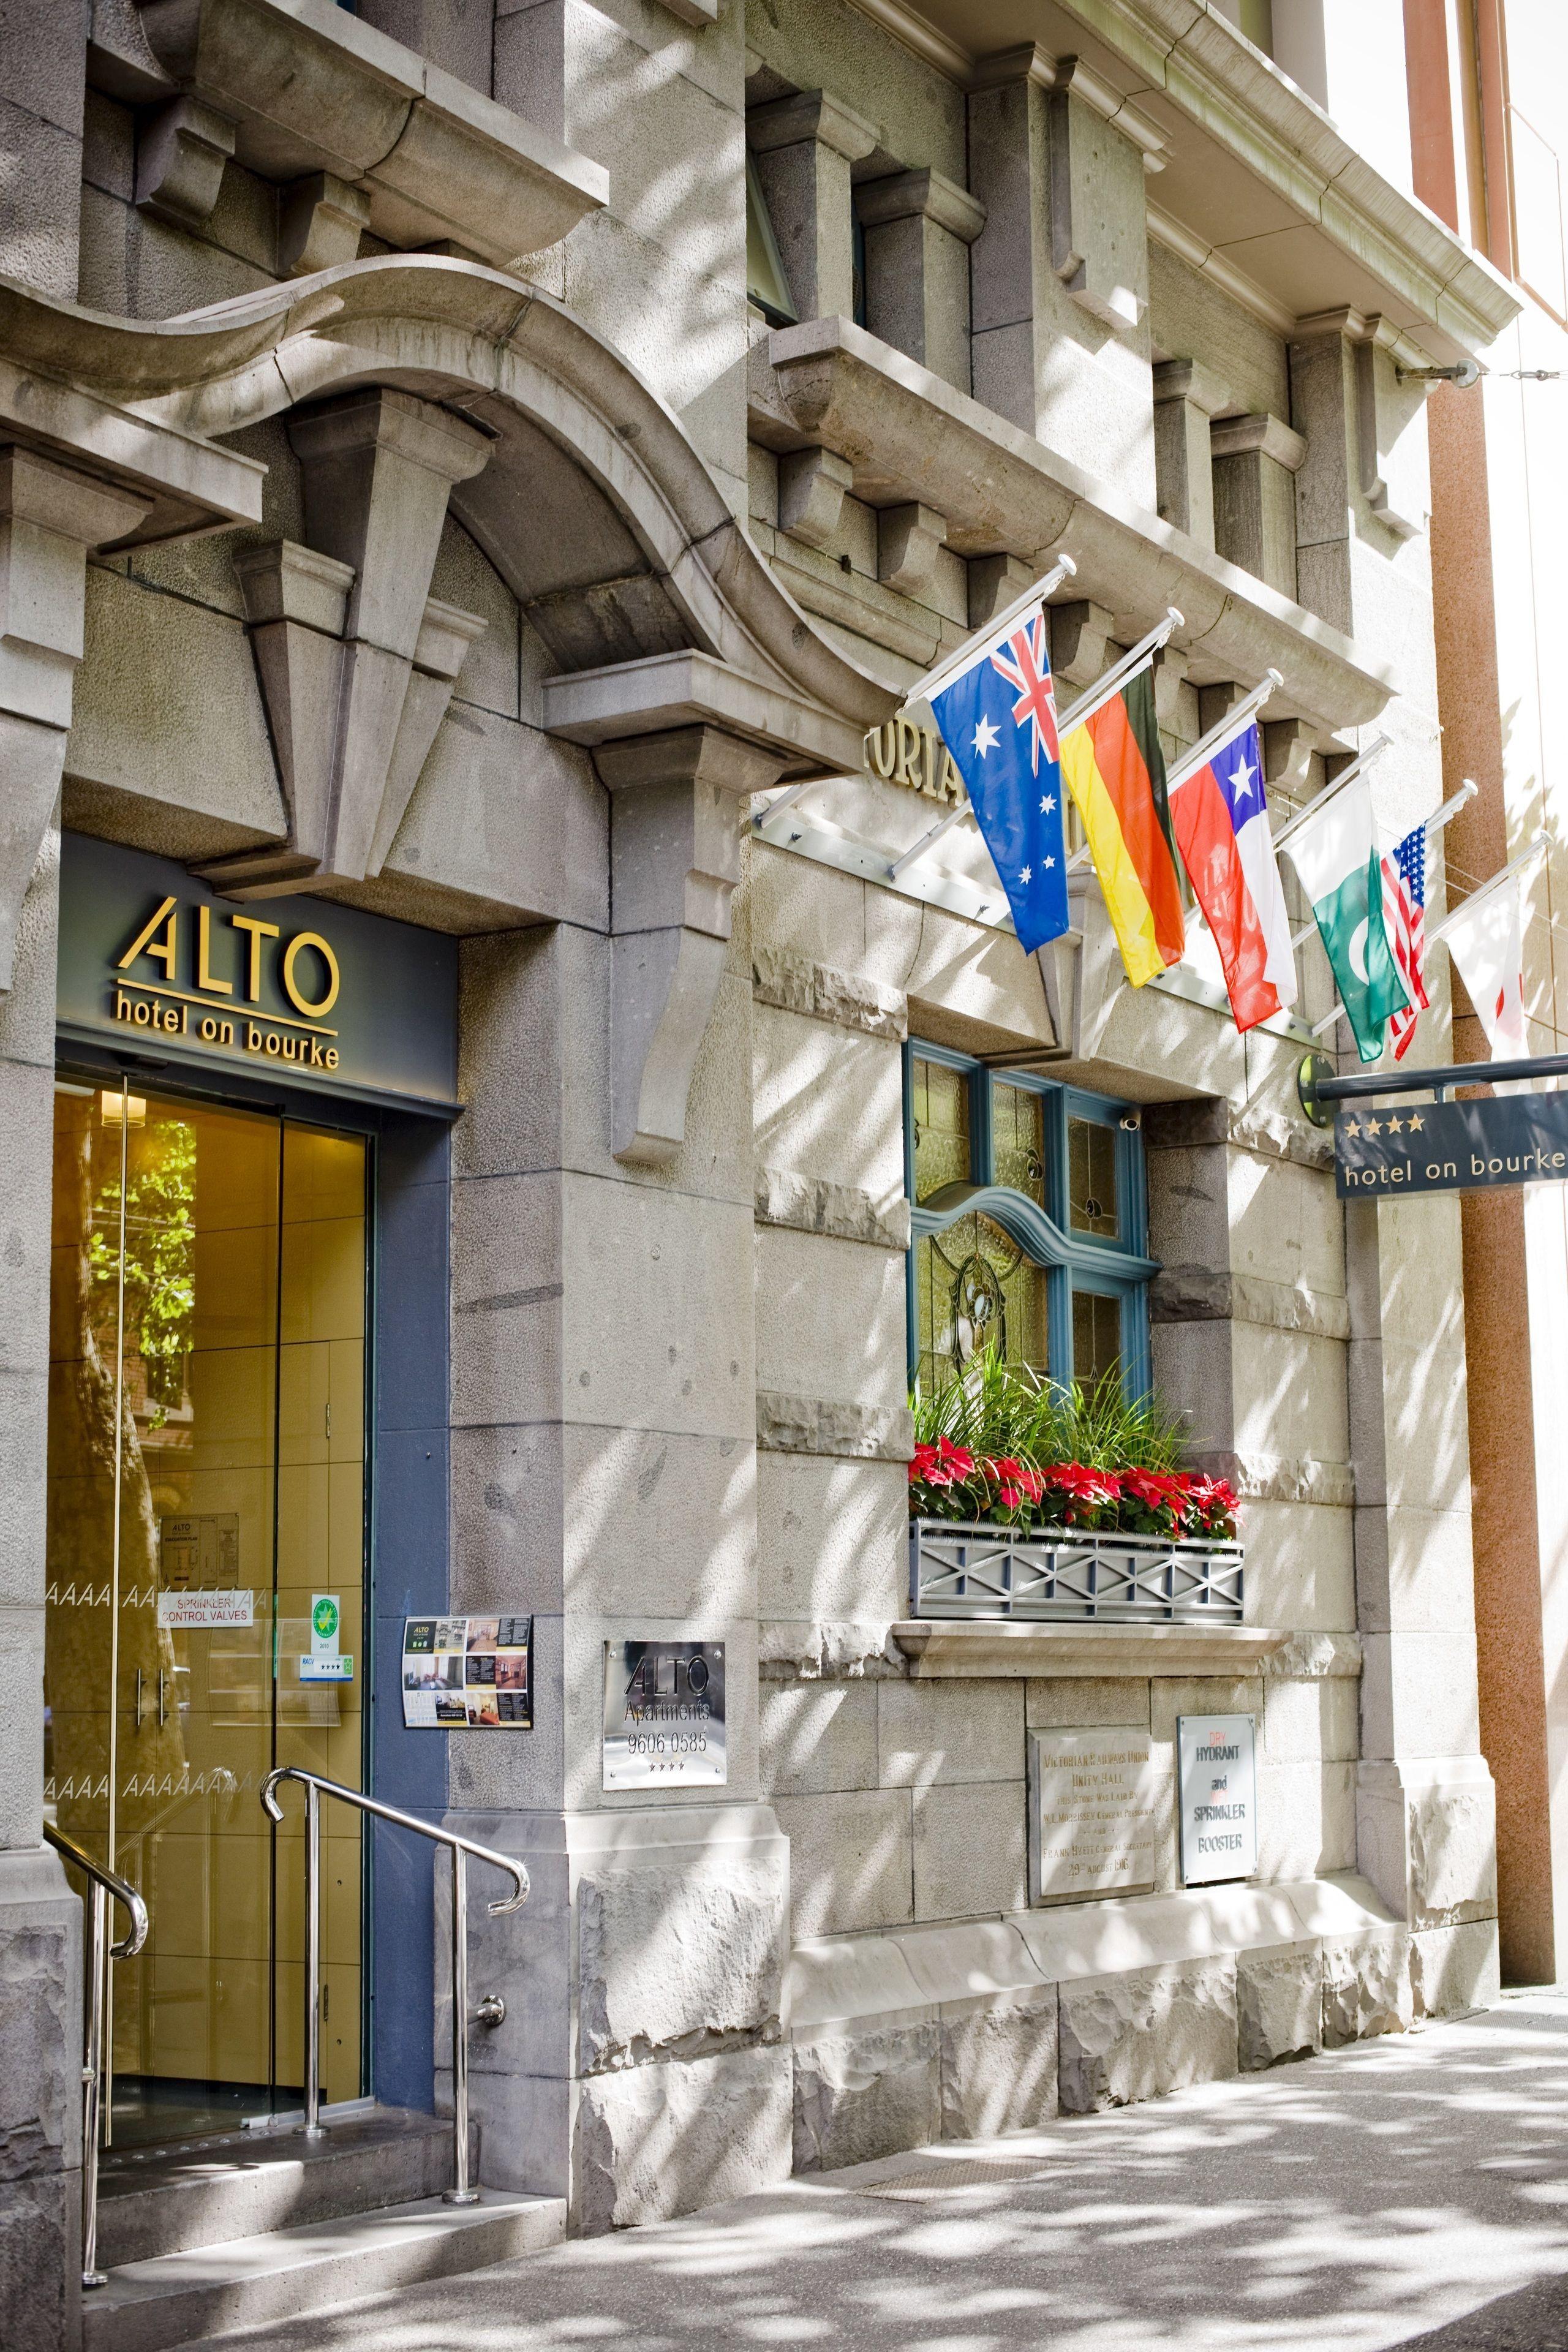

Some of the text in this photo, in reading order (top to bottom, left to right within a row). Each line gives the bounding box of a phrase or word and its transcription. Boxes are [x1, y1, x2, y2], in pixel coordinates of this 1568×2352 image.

[117, 896, 340, 1017] ALTO
[117, 990, 339, 1069] hotel on bourke
[1346, 1148, 1566, 1186] hotel on bourke
[178, 1598, 232, 1610] SPRINKLER
[162, 1610, 247, 1622] CONTROL VALVES
[624, 1655, 709, 1696] ALTO
[624, 1699, 710, 1727] Apartments
[628, 1731, 706, 1754] 9606 0585
[1209, 1732, 1226, 1746] DRY
[1044, 1751, 1149, 1768] VICTORIAN RAILWAYS UNION
[1196, 1745, 1240, 1762] HYDRANT
[1072, 1772, 1124, 1787] UNITY HALL
[1212, 1775, 1228, 1790] and
[1074, 1795, 1093, 1804] STONE
[1194, 1803, 1246, 1822] SPRINKLER
[1198, 1833, 1242, 1853] BOOSTER
[1043, 1847, 1069, 1859] FRANK
[1087, 1863, 1113, 1875] AUGUST
